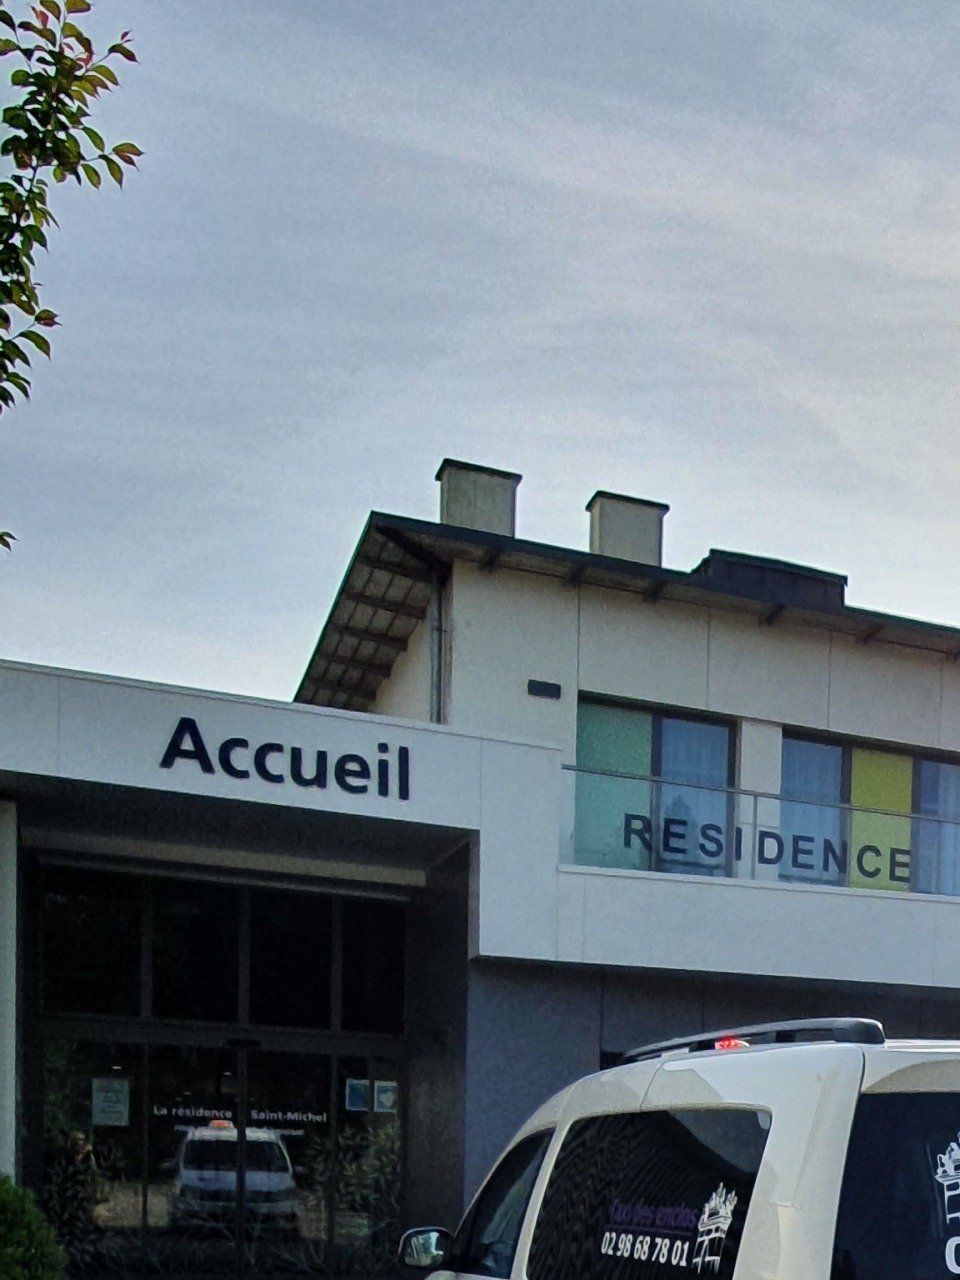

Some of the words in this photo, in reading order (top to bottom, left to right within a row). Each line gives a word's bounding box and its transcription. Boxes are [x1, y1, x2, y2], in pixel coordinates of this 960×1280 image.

[159, 717, 410, 801] Accueil
[623, 813, 911, 884] RESIDENCE
[153, 1105, 168, 1116] La
[172, 1106, 233, 1119] résidence
[251, 1109, 327, 1123] Saint-Michel
[601, 1231, 616, 1256] 02
[616, 1233, 633, 1258] 98
[634, 1235, 651, 1261] 68
[652, 1237, 670, 1264] 78
[671, 1239, 689, 1267] 01
